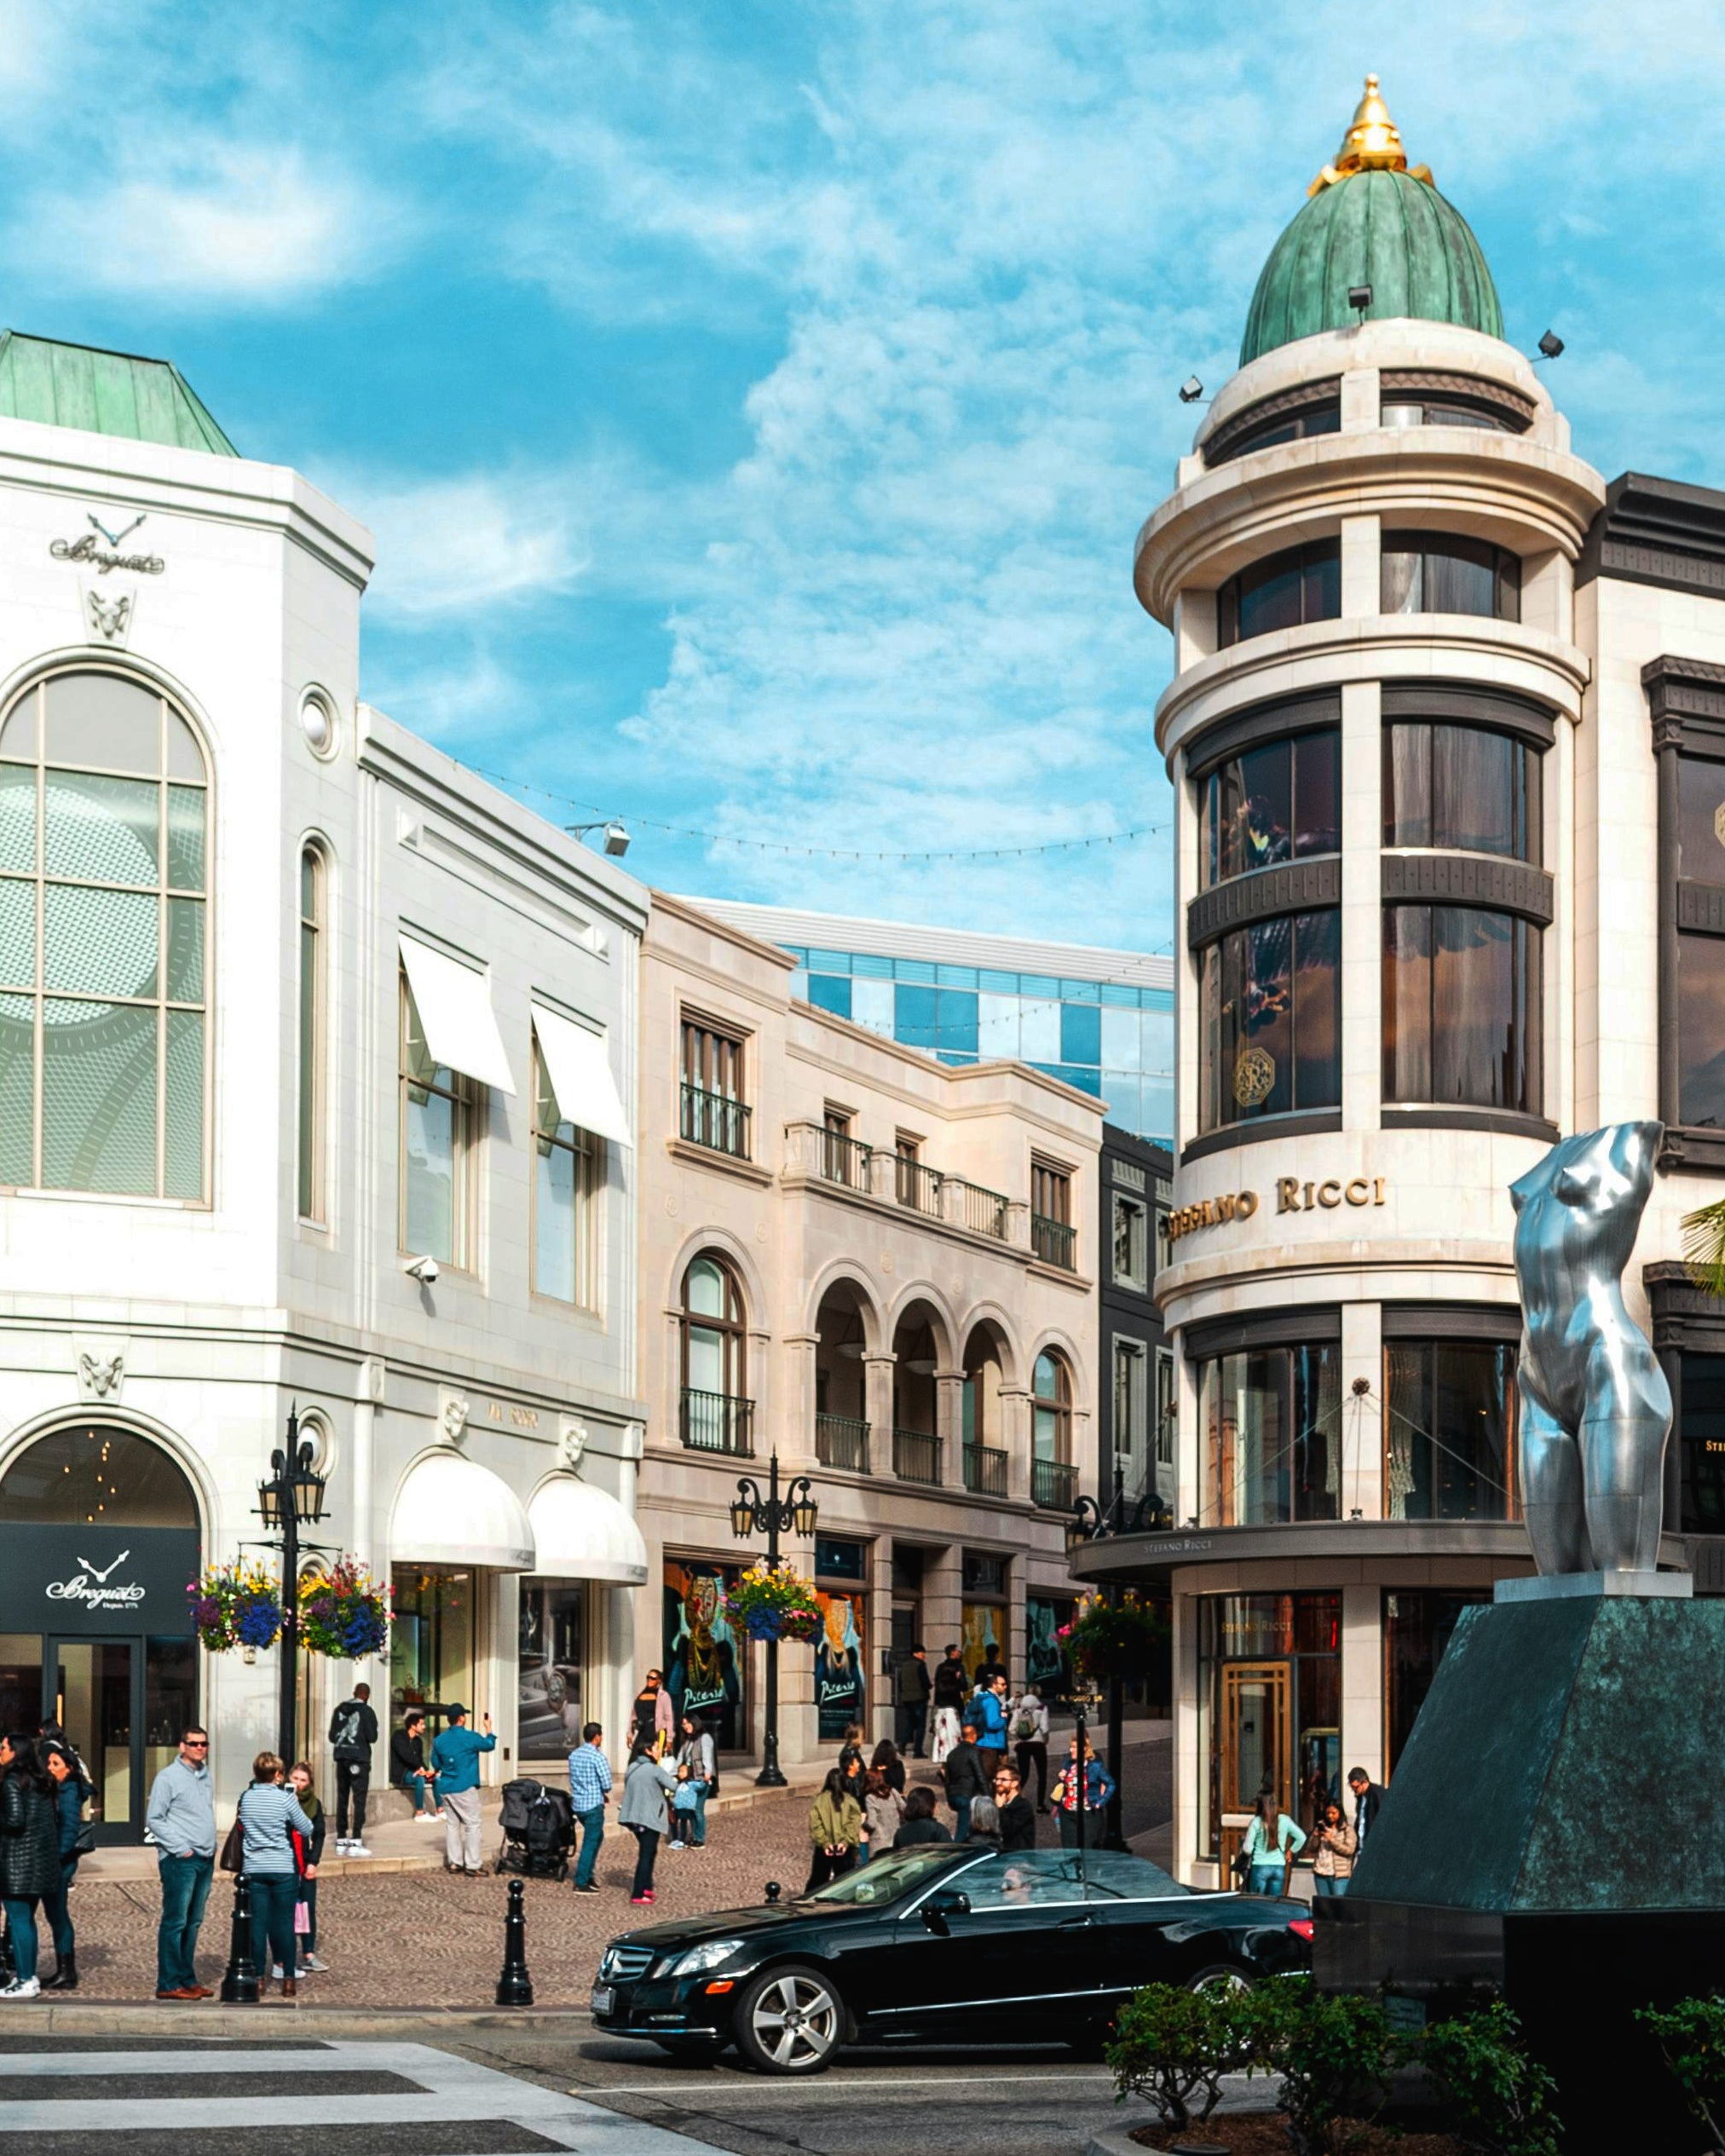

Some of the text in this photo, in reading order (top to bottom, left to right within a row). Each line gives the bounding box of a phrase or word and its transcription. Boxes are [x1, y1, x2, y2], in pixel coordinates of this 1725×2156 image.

[49, 534, 164, 574] Breguet
[1276, 1175, 1386, 1215] RICCI
[1184, 1539, 1212, 1550] RICCI
[46, 1575, 145, 1609] Breguet
[1261, 1620, 1292, 1632] RICCI
